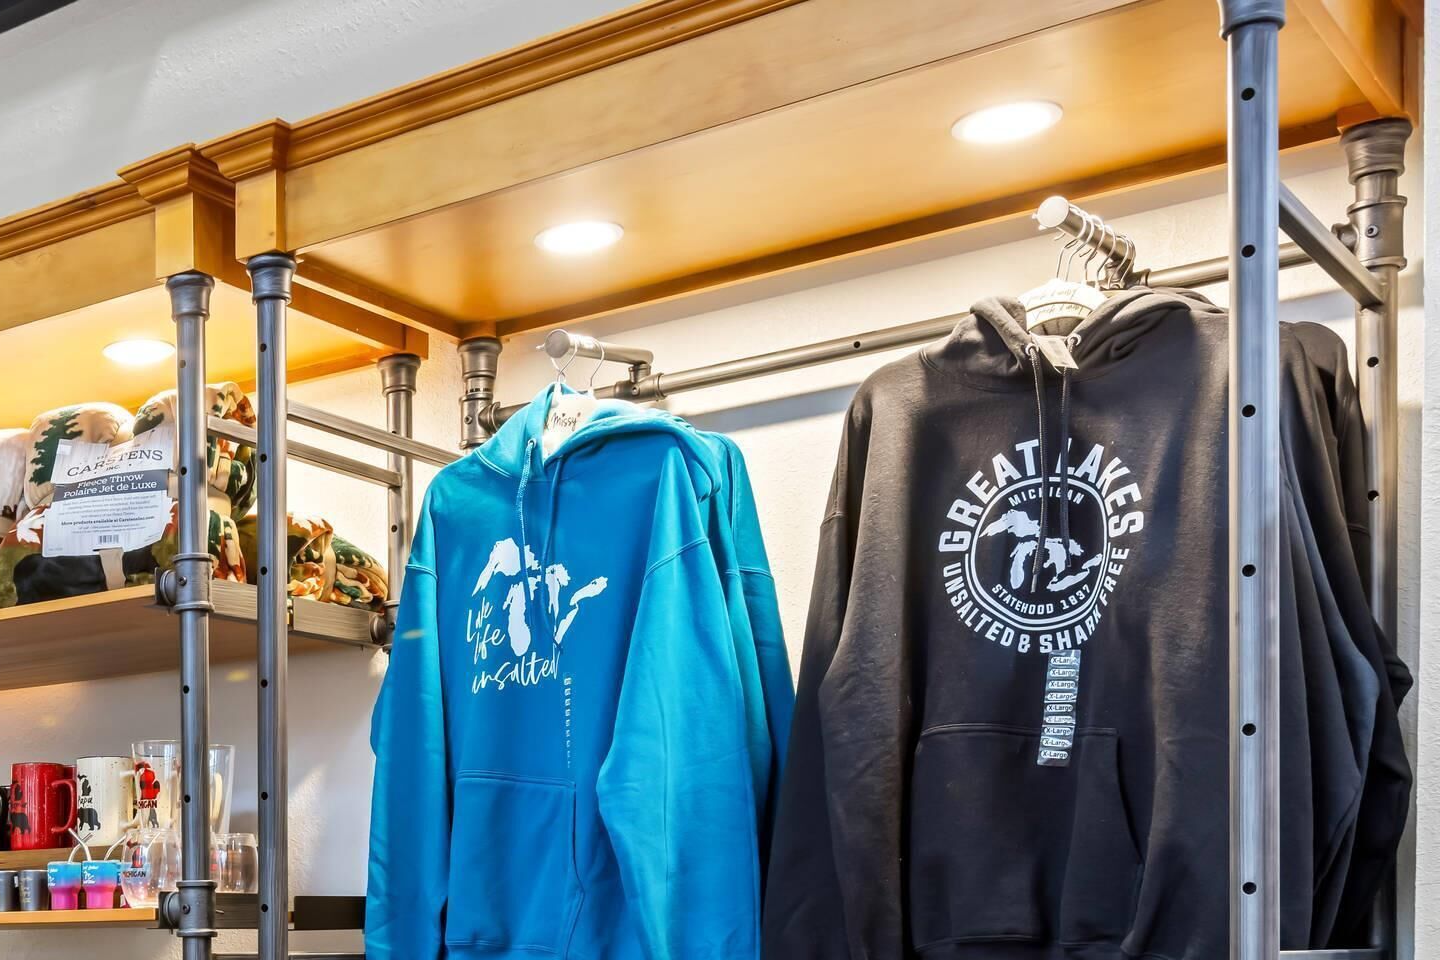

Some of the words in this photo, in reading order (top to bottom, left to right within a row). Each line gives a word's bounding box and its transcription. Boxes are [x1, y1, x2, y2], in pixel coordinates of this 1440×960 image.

[63, 488, 97, 499] Polaire
[98, 484, 115, 493] Jet
[117, 482, 129, 491] de
[131, 480, 158, 490] Luxe
[109, 473, 144, 483] Throw
[1055, 437, 1145, 539] LAKES
[938, 438, 1040, 553] GREAT
[943, 562, 1015, 648] UNSALTED
[1017, 634, 1031, 654] &
[1039, 609, 1103, 654] SHARK
[1099, 547, 1130, 607] FREE
[991, 583, 1055, 615] STATEHOOD
[1062, 585, 1091, 611] 1837
[1042, 751, 1067, 759] X-Large
